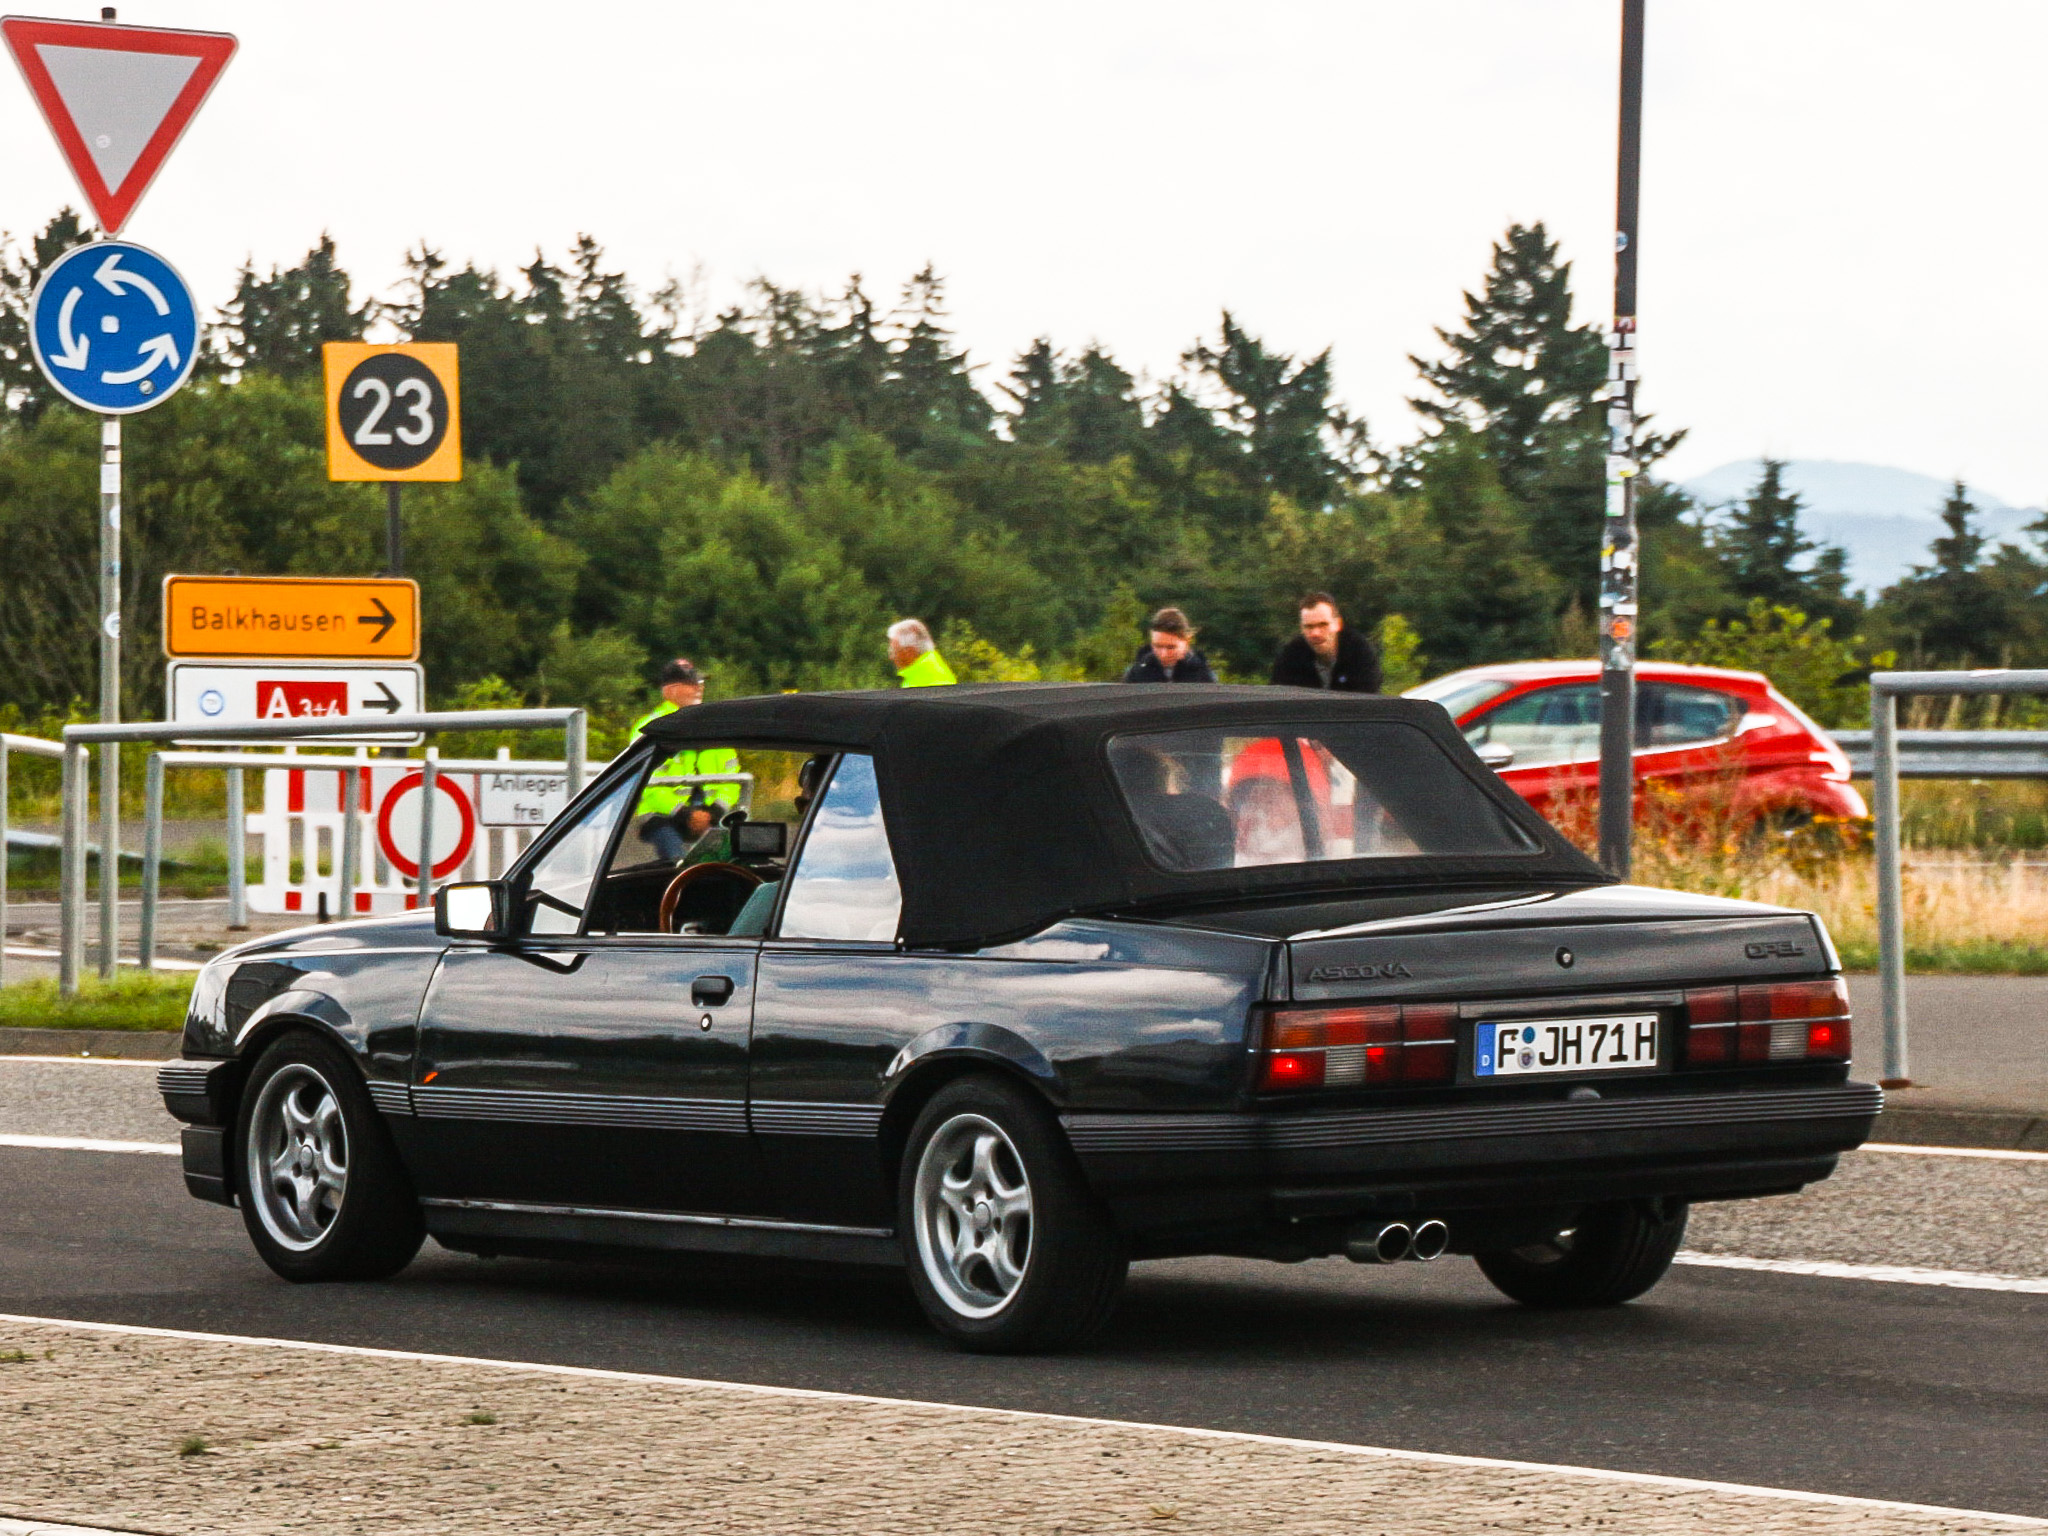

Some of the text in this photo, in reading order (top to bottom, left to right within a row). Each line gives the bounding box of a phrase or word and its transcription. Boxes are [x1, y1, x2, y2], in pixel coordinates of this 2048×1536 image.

[353, 378, 434, 446] 23
[191, 606, 346, 632] Balkhausen
[264, 686, 293, 719] A
[492, 774, 567, 797] Anlieger
[514, 803, 544, 821] frei
[1744, 941, 1805, 959] OPEL
[1307, 963, 1414, 982] ASCONA
[1481, 1054, 1491, 1067] D
